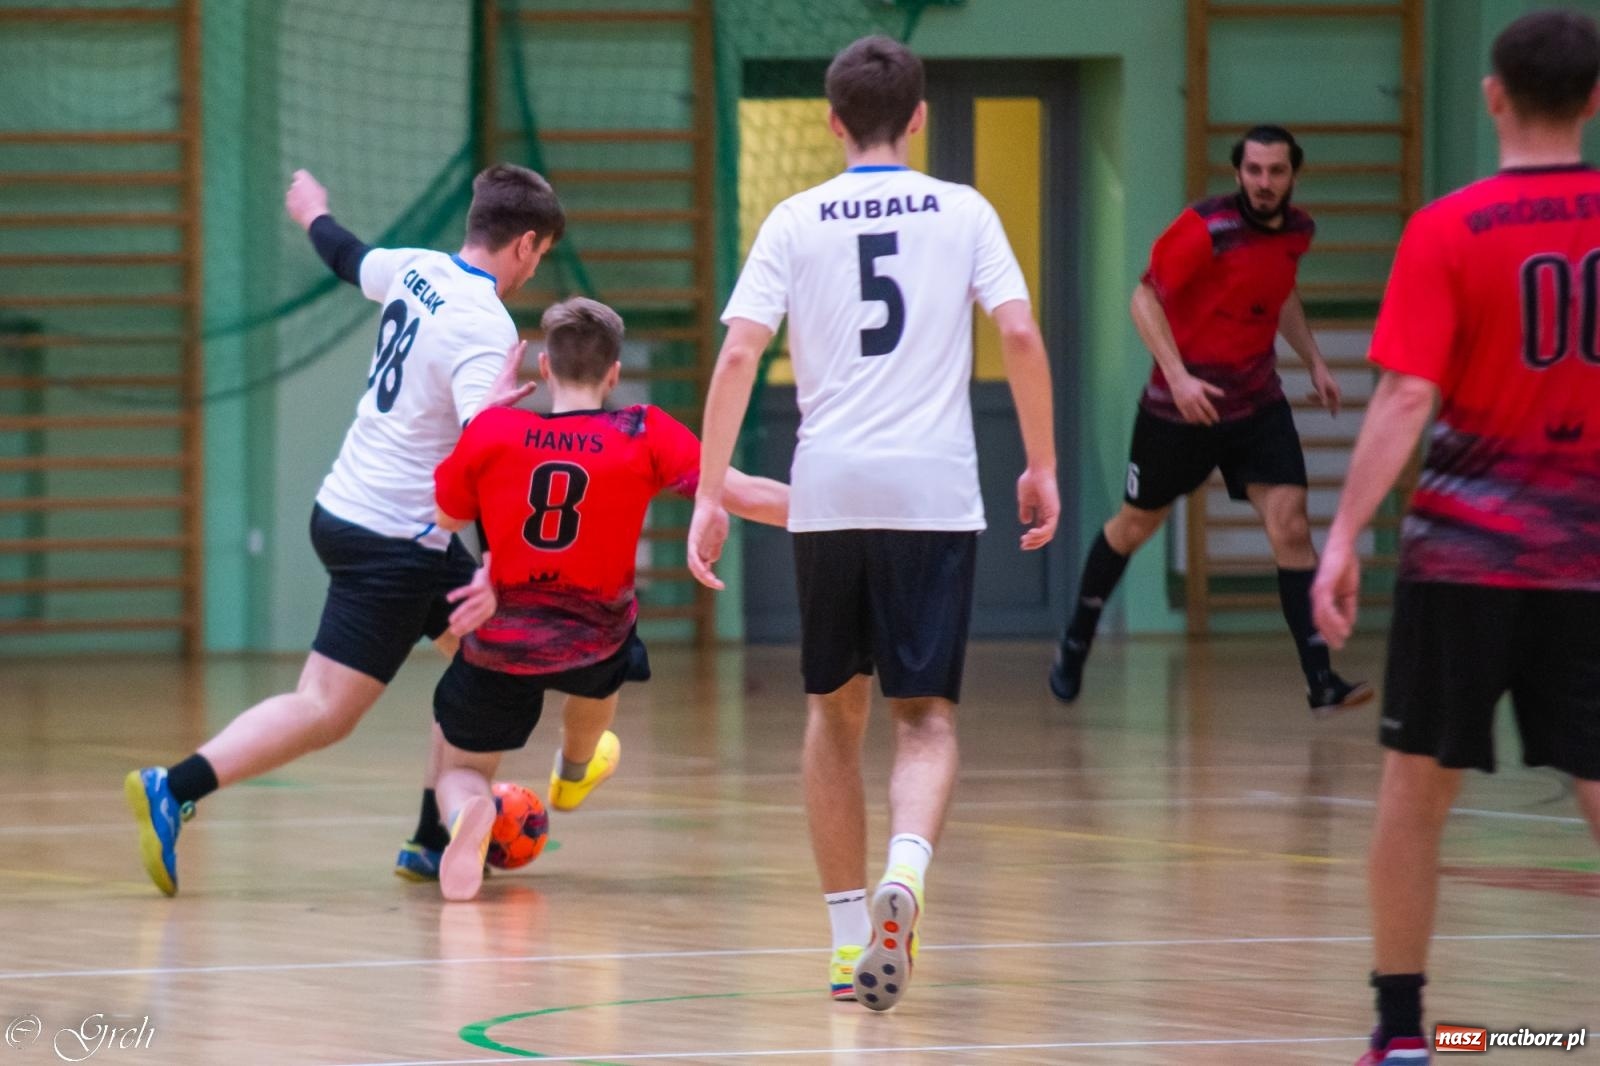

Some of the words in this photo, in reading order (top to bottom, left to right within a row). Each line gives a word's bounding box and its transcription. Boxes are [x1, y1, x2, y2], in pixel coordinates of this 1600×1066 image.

[819, 194, 941, 222] KUBALA
[402, 268, 446, 316] CIELAK
[857, 230, 906, 357] 5
[368, 298, 421, 413] 98
[524, 428, 604, 454] HANYS
[1127, 462, 1140, 500] 6
[521, 460, 591, 552] 8
